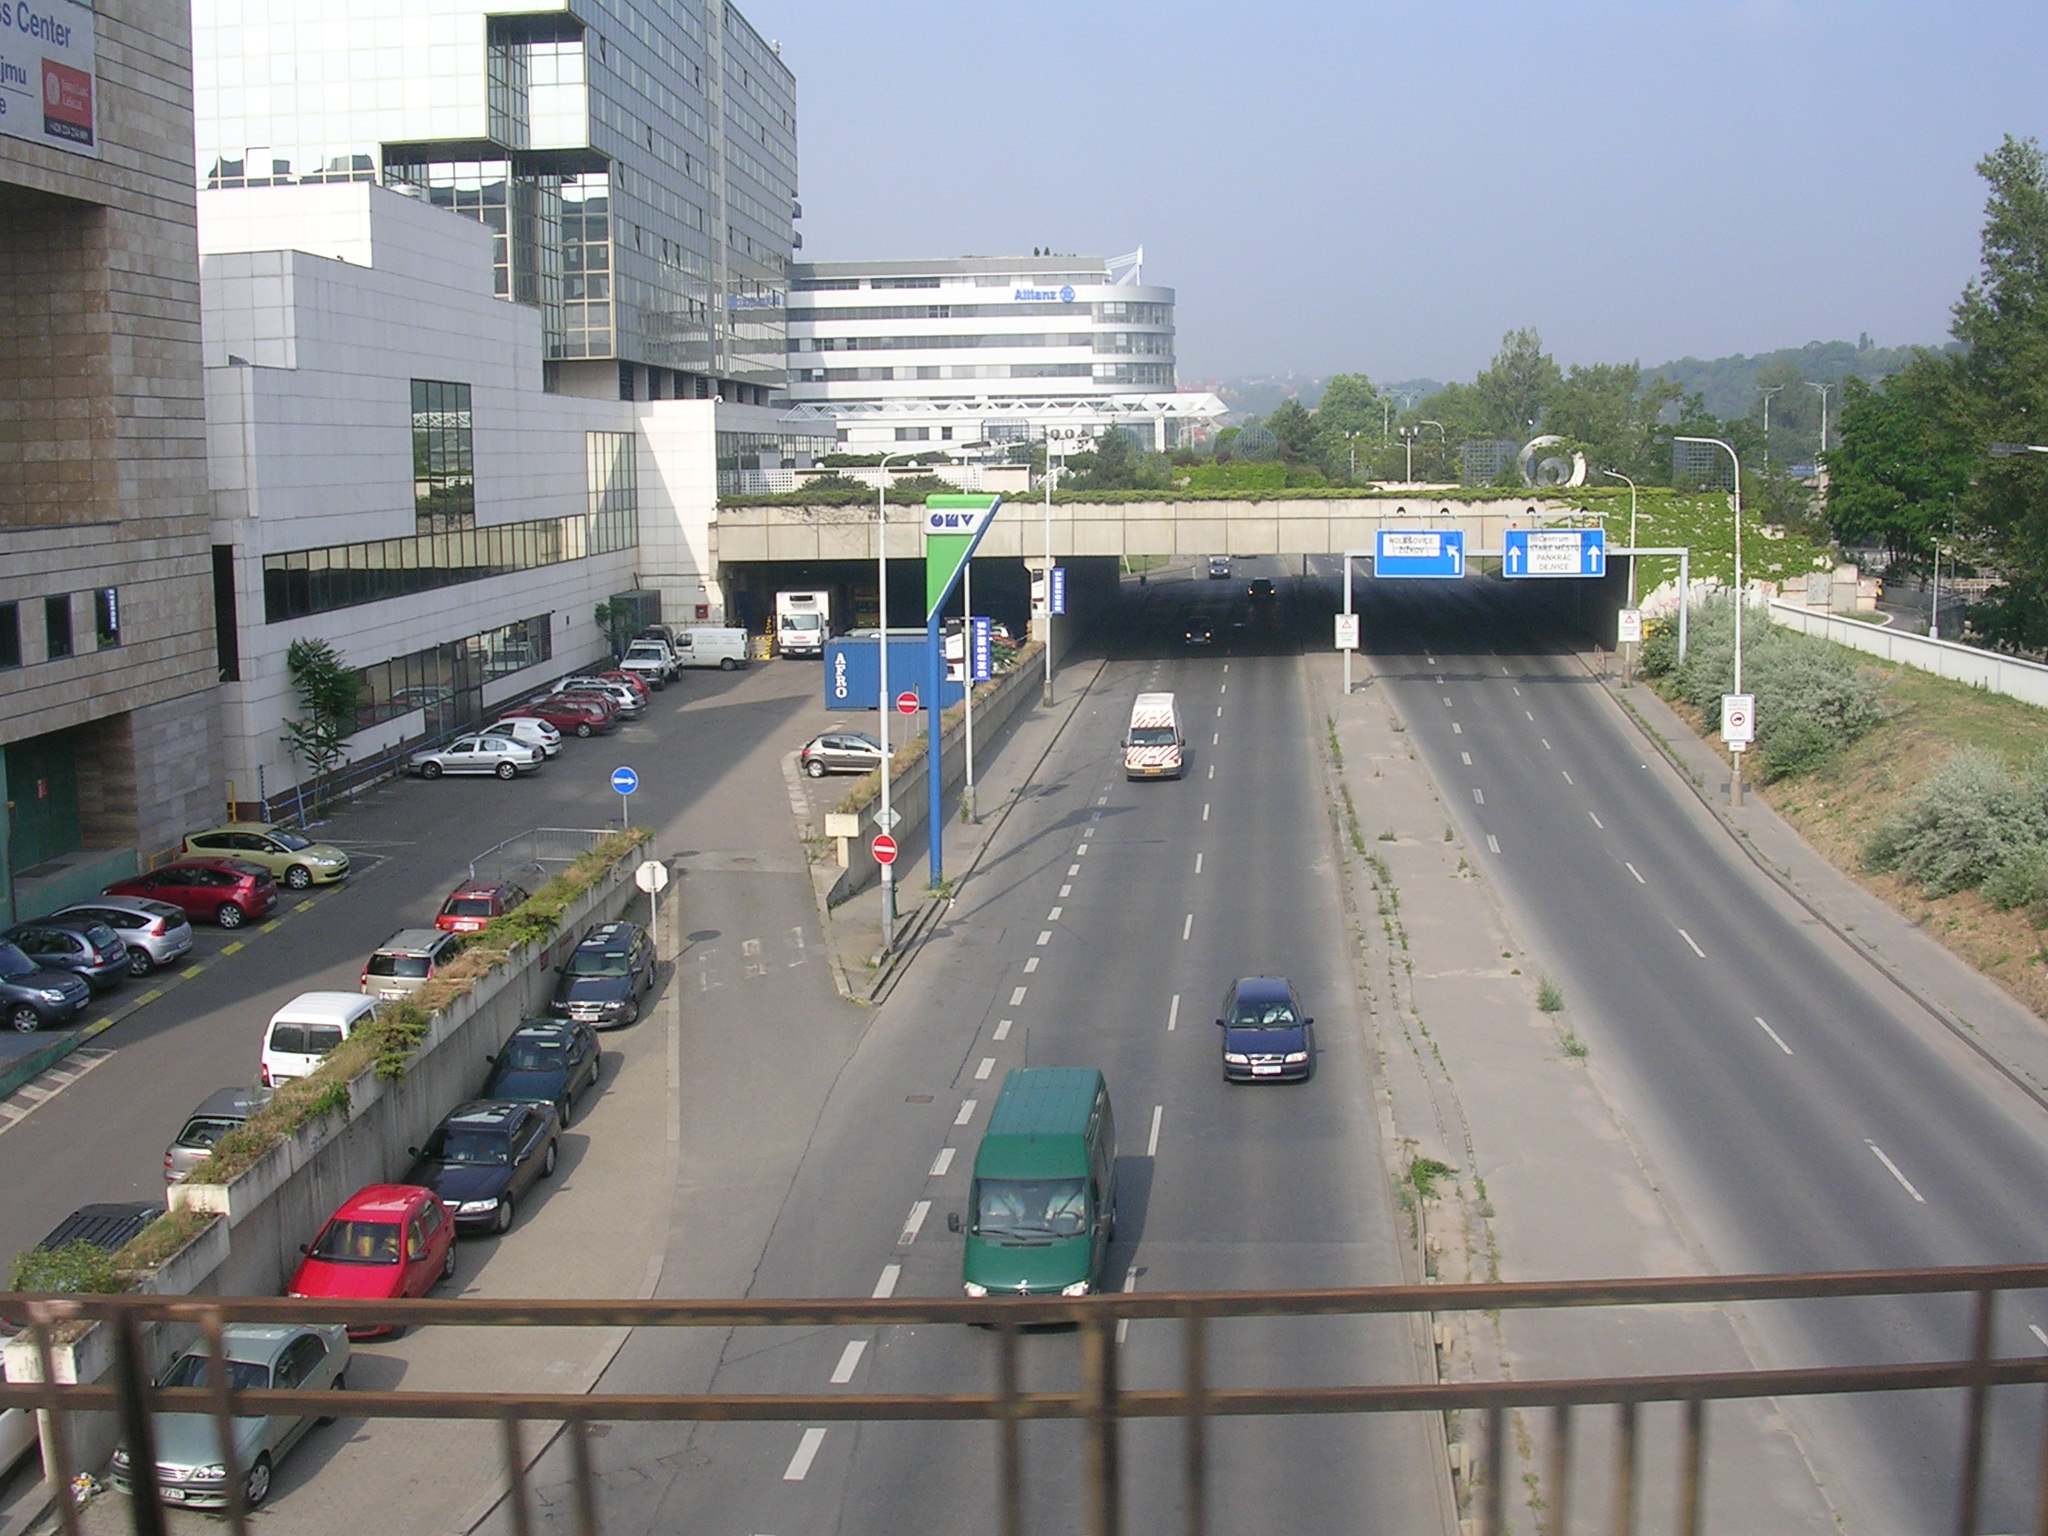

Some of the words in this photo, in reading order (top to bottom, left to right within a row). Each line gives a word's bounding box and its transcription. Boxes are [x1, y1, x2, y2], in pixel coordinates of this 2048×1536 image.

[0, 1, 12, 27] s
[17, 1, 71, 48] Center
[1014, 289, 1057, 301] Allianz
[930, 513, 974, 528] OMV
[1539, 535, 1570, 543] Centrum
[1538, 563, 1570, 571] DEJVICE
[1054, 571, 1063, 612] SAMSUNG
[976, 621, 988, 678] SAMSUNG
[835, 652, 848, 699] AFRO
